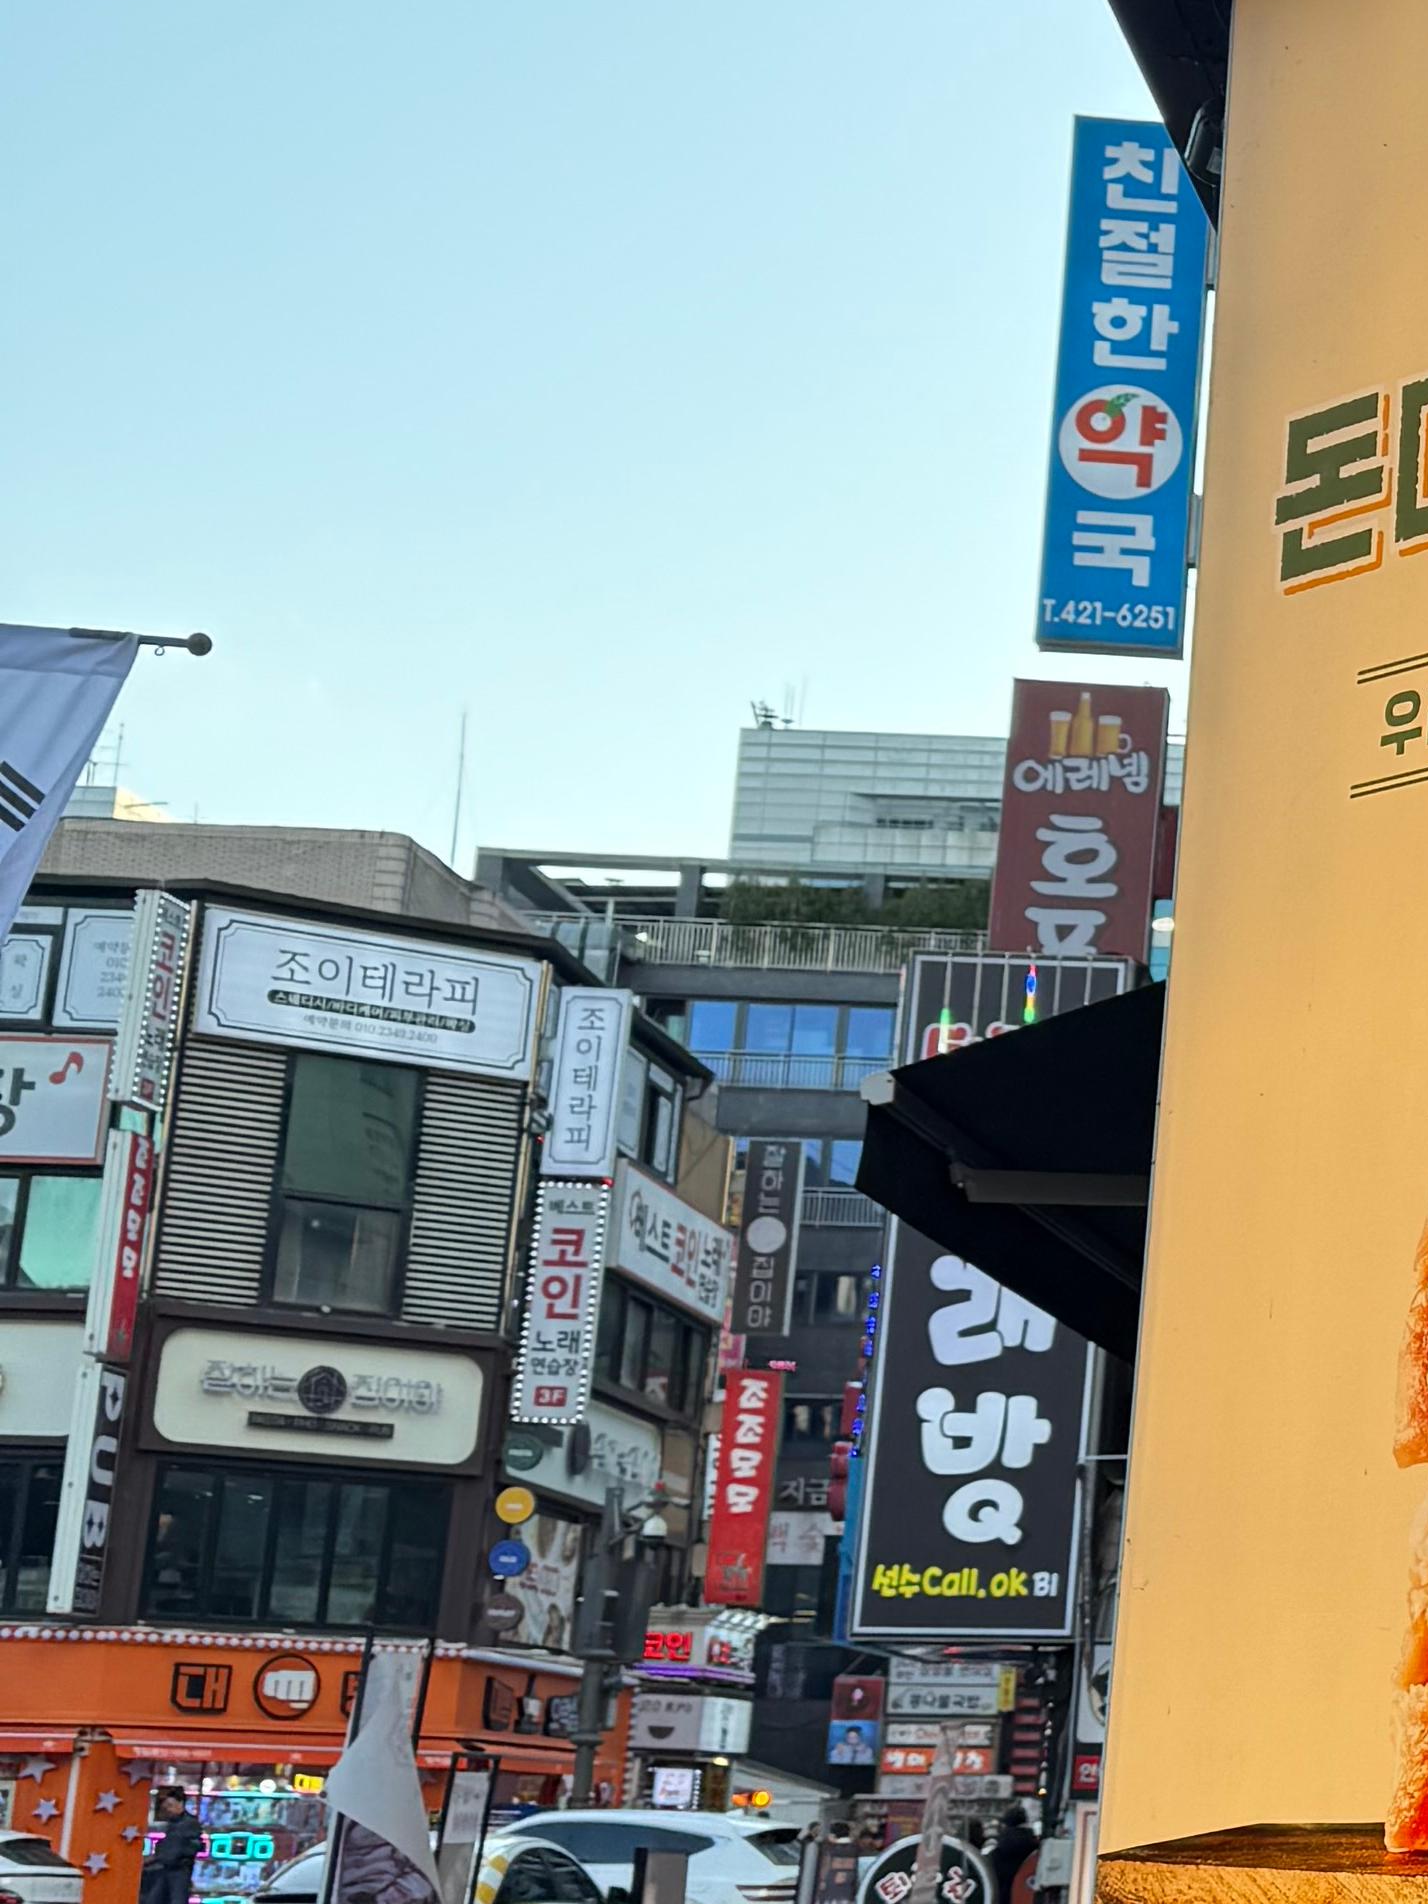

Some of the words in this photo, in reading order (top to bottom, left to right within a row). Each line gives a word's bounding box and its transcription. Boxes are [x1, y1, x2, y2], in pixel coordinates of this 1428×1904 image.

[1042, 599, 1175, 631] T.421-6251
[271, 948, 479, 1016] 조이테라피
[565, 1008, 606, 1152] 조이테라피
[549, 1199, 595, 1215] 베스트
[541, 1227, 588, 1320] 코인
[531, 1330, 581, 1354] 노래
[531, 1357, 579, 1376] 연습장
[538, 1390, 563, 1403] 3F
[643, 1631, 693, 1663] 코인
